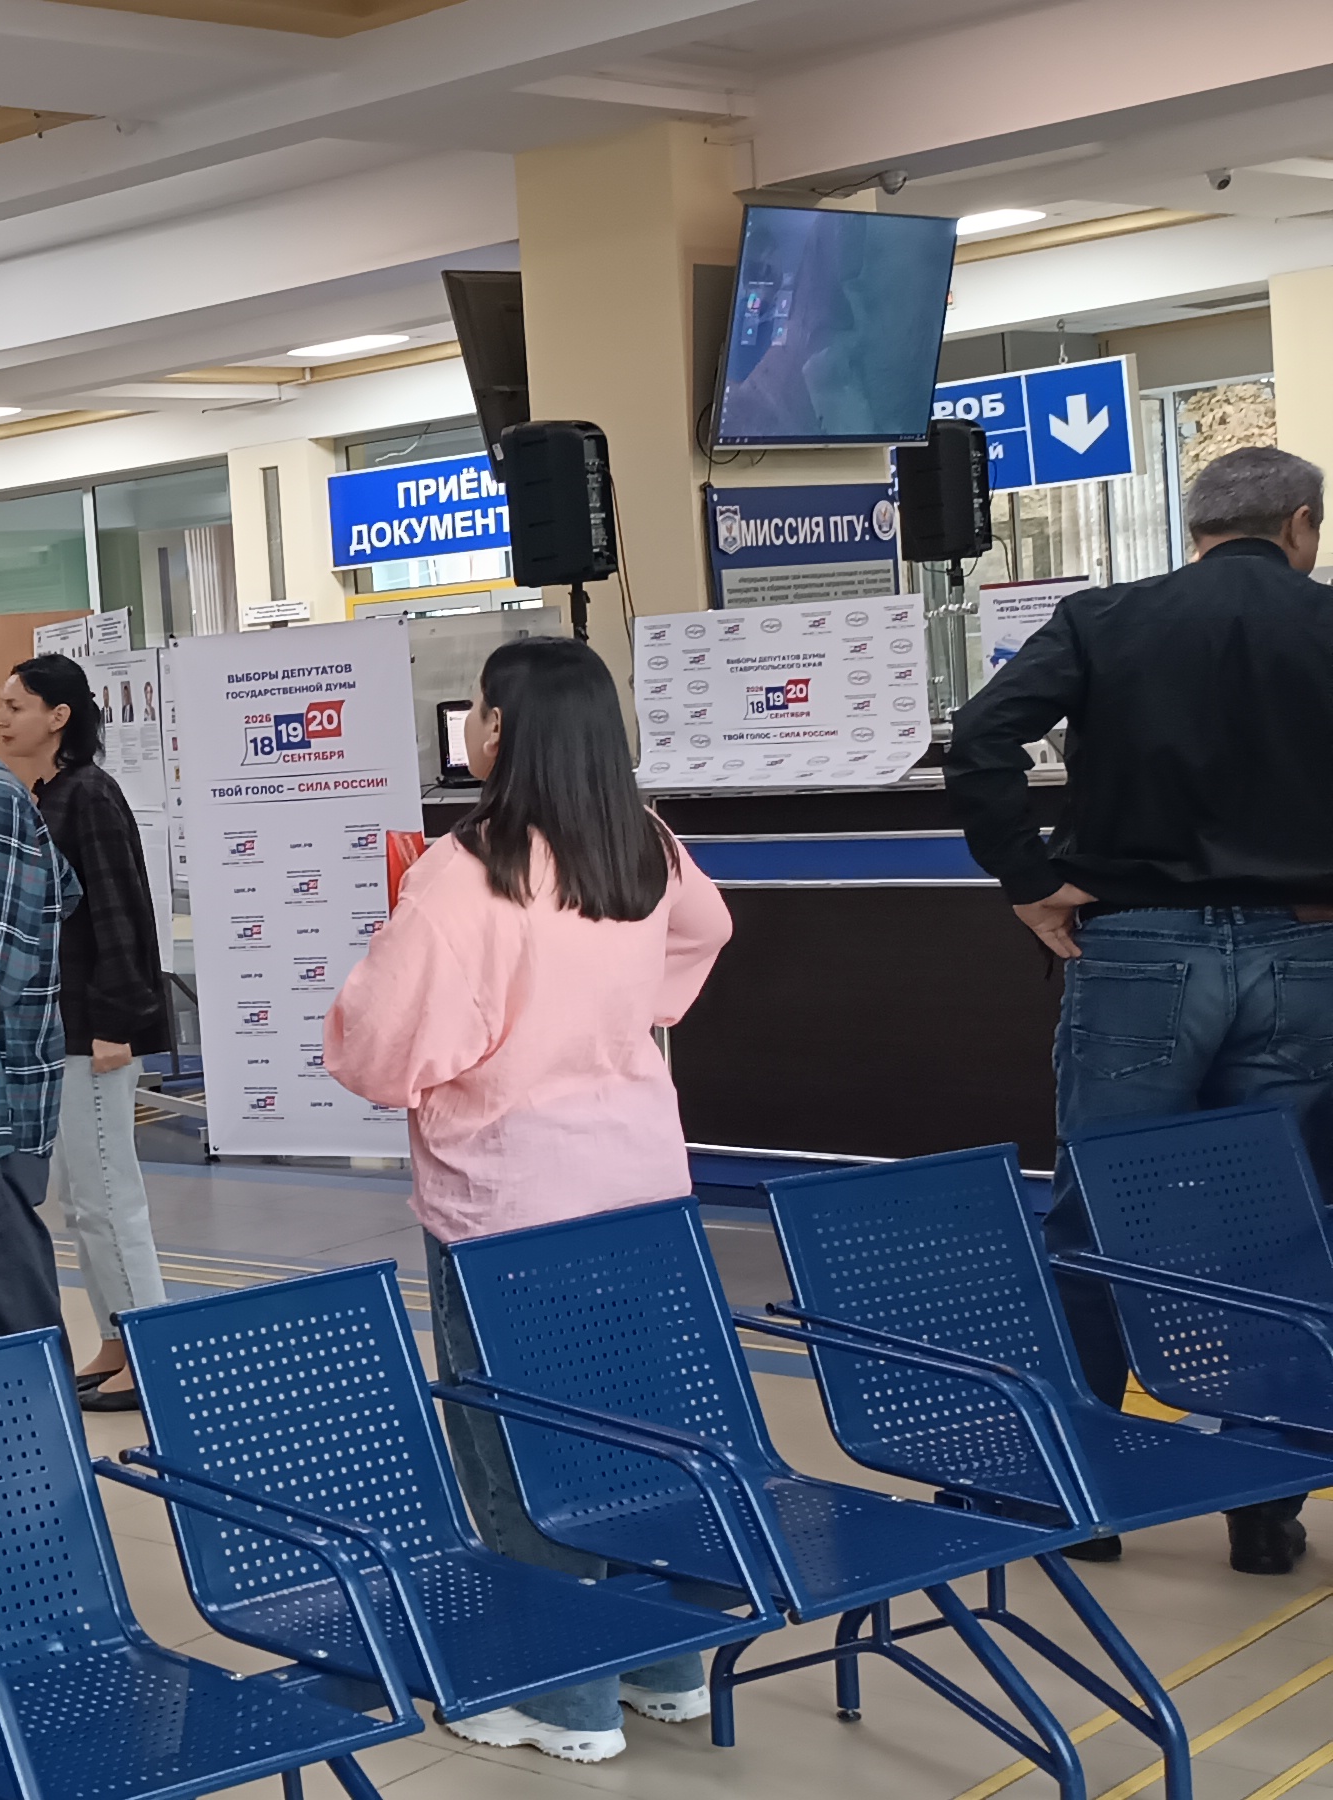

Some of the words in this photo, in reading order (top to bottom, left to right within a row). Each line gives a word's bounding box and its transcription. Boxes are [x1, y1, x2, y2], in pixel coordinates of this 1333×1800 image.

[933, 392, 1005, 420] РОБ
[989, 442, 1004, 460] Й
[397, 466, 506, 509] ПРИЁМ
[349, 505, 510, 556] ДОКУМЕНТ
[741, 517, 824, 547] МИССИЯ
[829, 514, 870, 543] ПГУ:
[758, 653, 801, 663] ДЕПУТАТОВ
[802, 652, 826, 661] ДУМЫ
[227, 670, 279, 684] ВЫБОРЫ
[281, 663, 353, 680] ДЕПУТАТОВ
[225, 682, 323, 700] ГОСУДАРСТВЕННОЙ
[324, 681, 356, 692] ДУМЫ
[749, 701, 765, 714] 18
[767, 691, 784, 706] 19
[786, 683, 807, 699] 20
[244, 714, 272, 725] 2026
[249, 736, 274, 757] 18
[277, 722, 303, 743] 19
[307, 709, 339, 732] 20
[722, 733, 744, 741] ТВОЙ
[745, 732, 771, 740] ГОЛОС
[779, 731, 801, 739] СИЛА
[283, 750, 345, 763] СЕНТЯБРЯ
[211, 785, 243, 798] ТВОЙ
[245, 784, 284, 796] ГОЛОС
[298, 781, 331, 793] СИЛА
[333, 777, 388, 791] РОССИИ!
